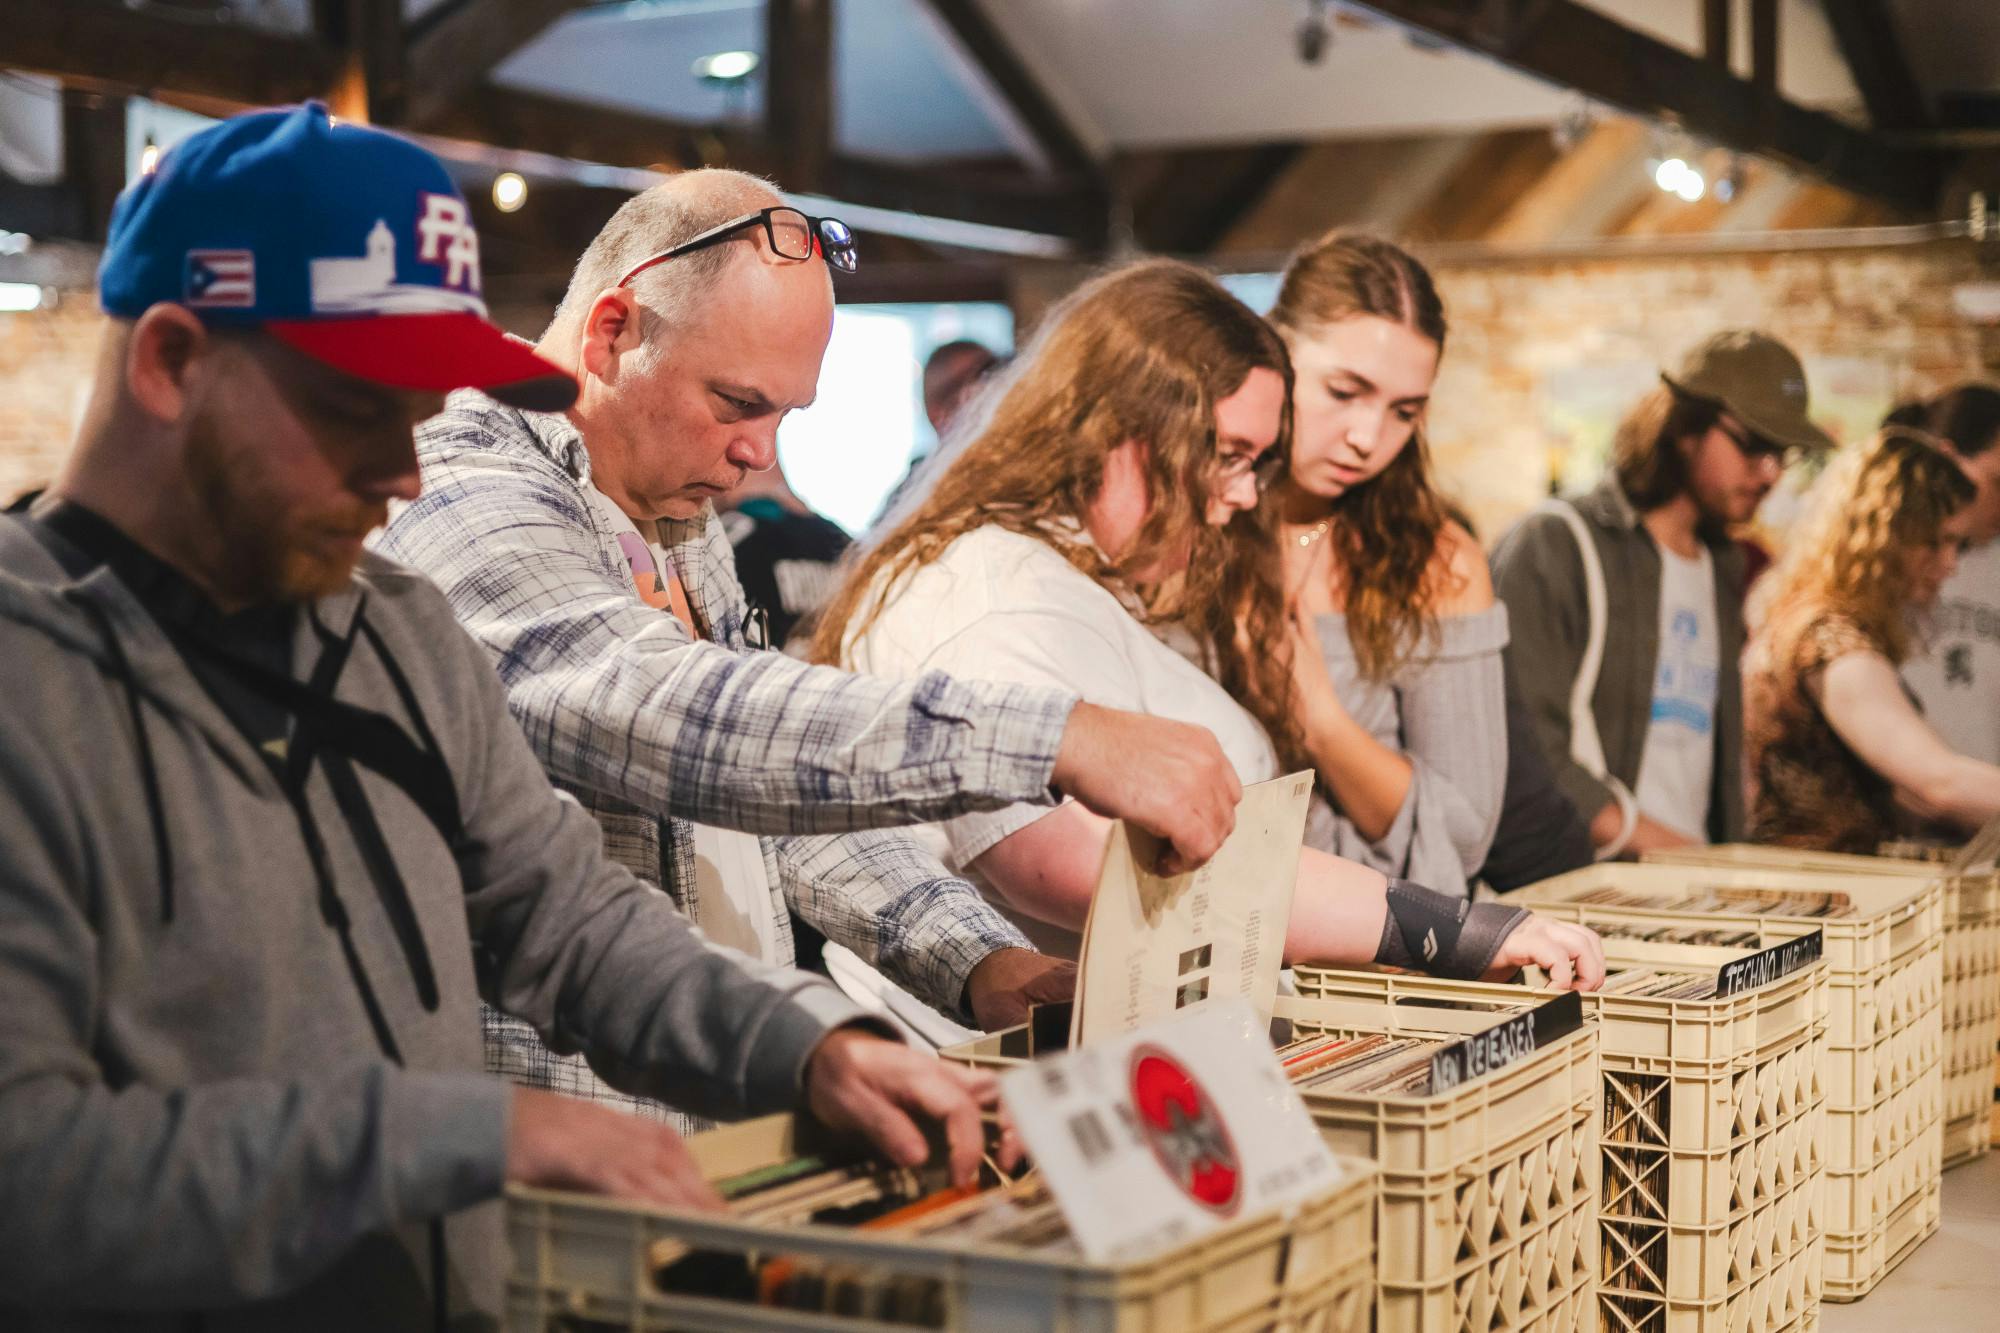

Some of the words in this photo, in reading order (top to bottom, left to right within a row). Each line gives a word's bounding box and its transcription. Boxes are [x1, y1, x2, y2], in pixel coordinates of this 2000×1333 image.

[1725, 950, 1776, 997] TECHNO
[1781, 935, 1820, 977] VARIO
[1432, 1049, 1460, 1096] NEW
[1465, 1012, 1536, 1080] RELEASES
